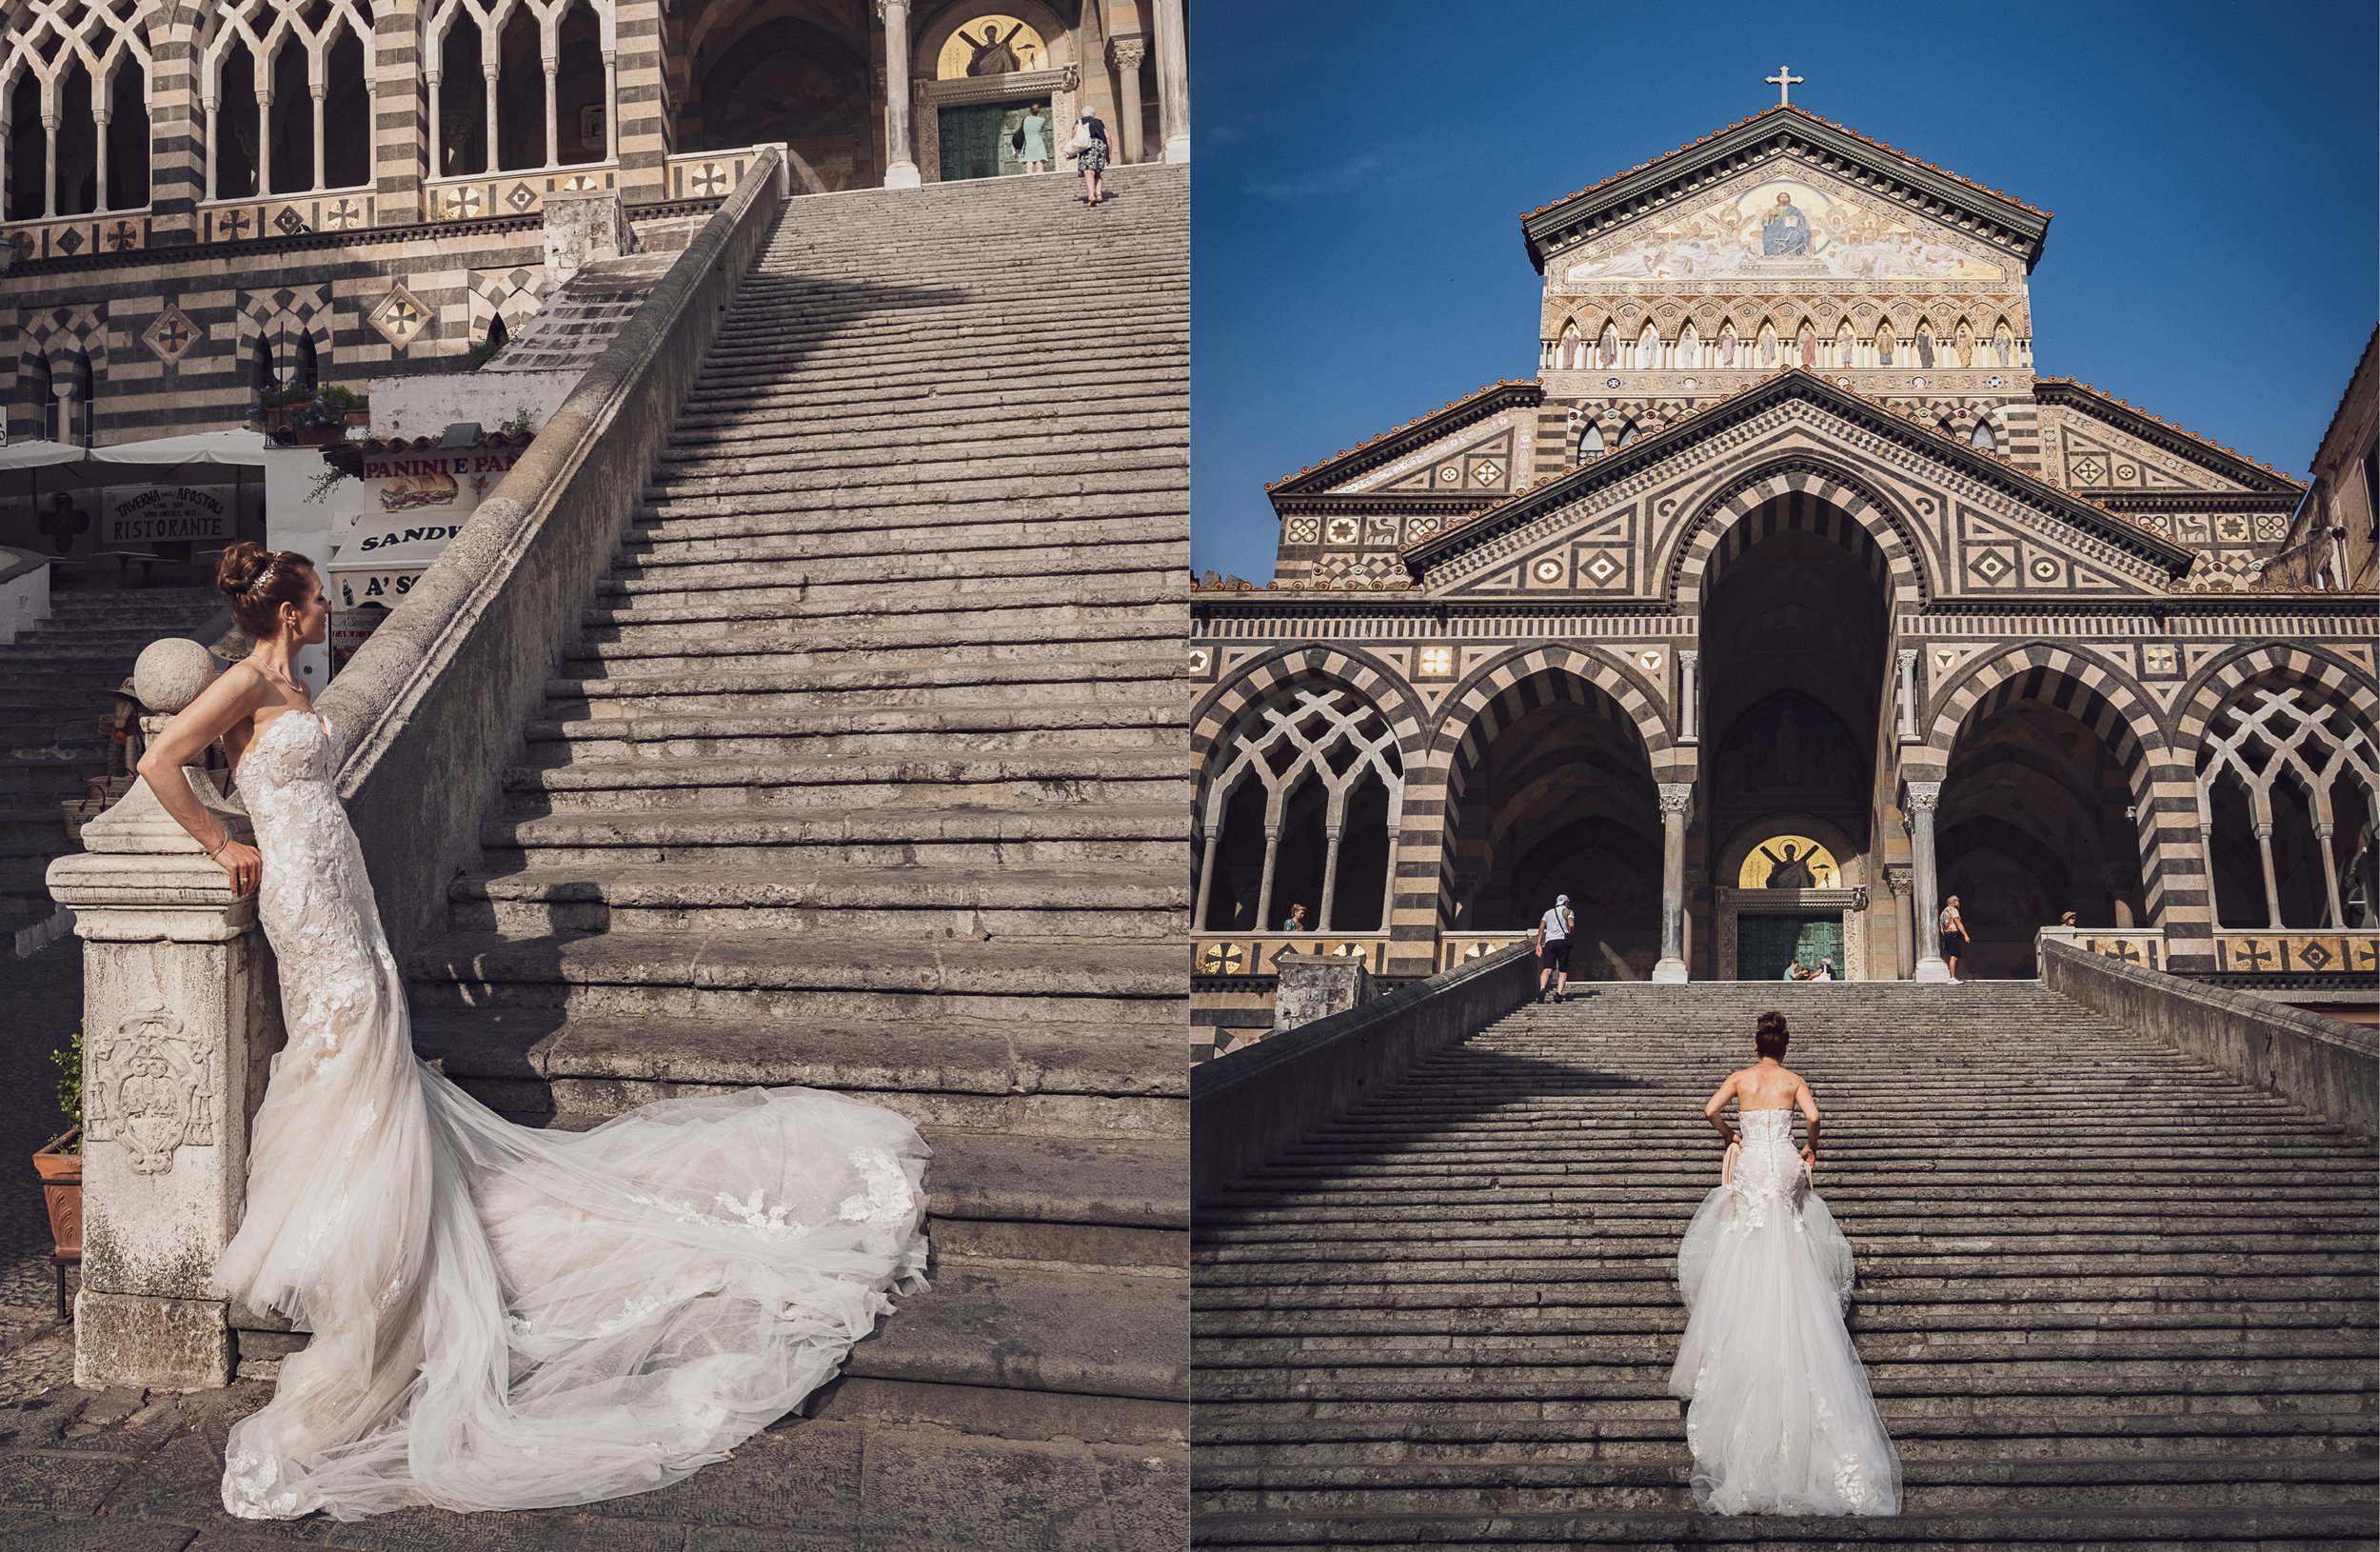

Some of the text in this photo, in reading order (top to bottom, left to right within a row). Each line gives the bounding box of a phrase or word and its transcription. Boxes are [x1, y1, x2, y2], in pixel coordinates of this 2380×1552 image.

[365, 458, 448, 479] PANINI
[453, 458, 468, 474] E
[114, 489, 162, 518] TAVERNA
[176, 487, 225, 516] APOSTOLI
[113, 517, 222, 541] RISTORANTE
